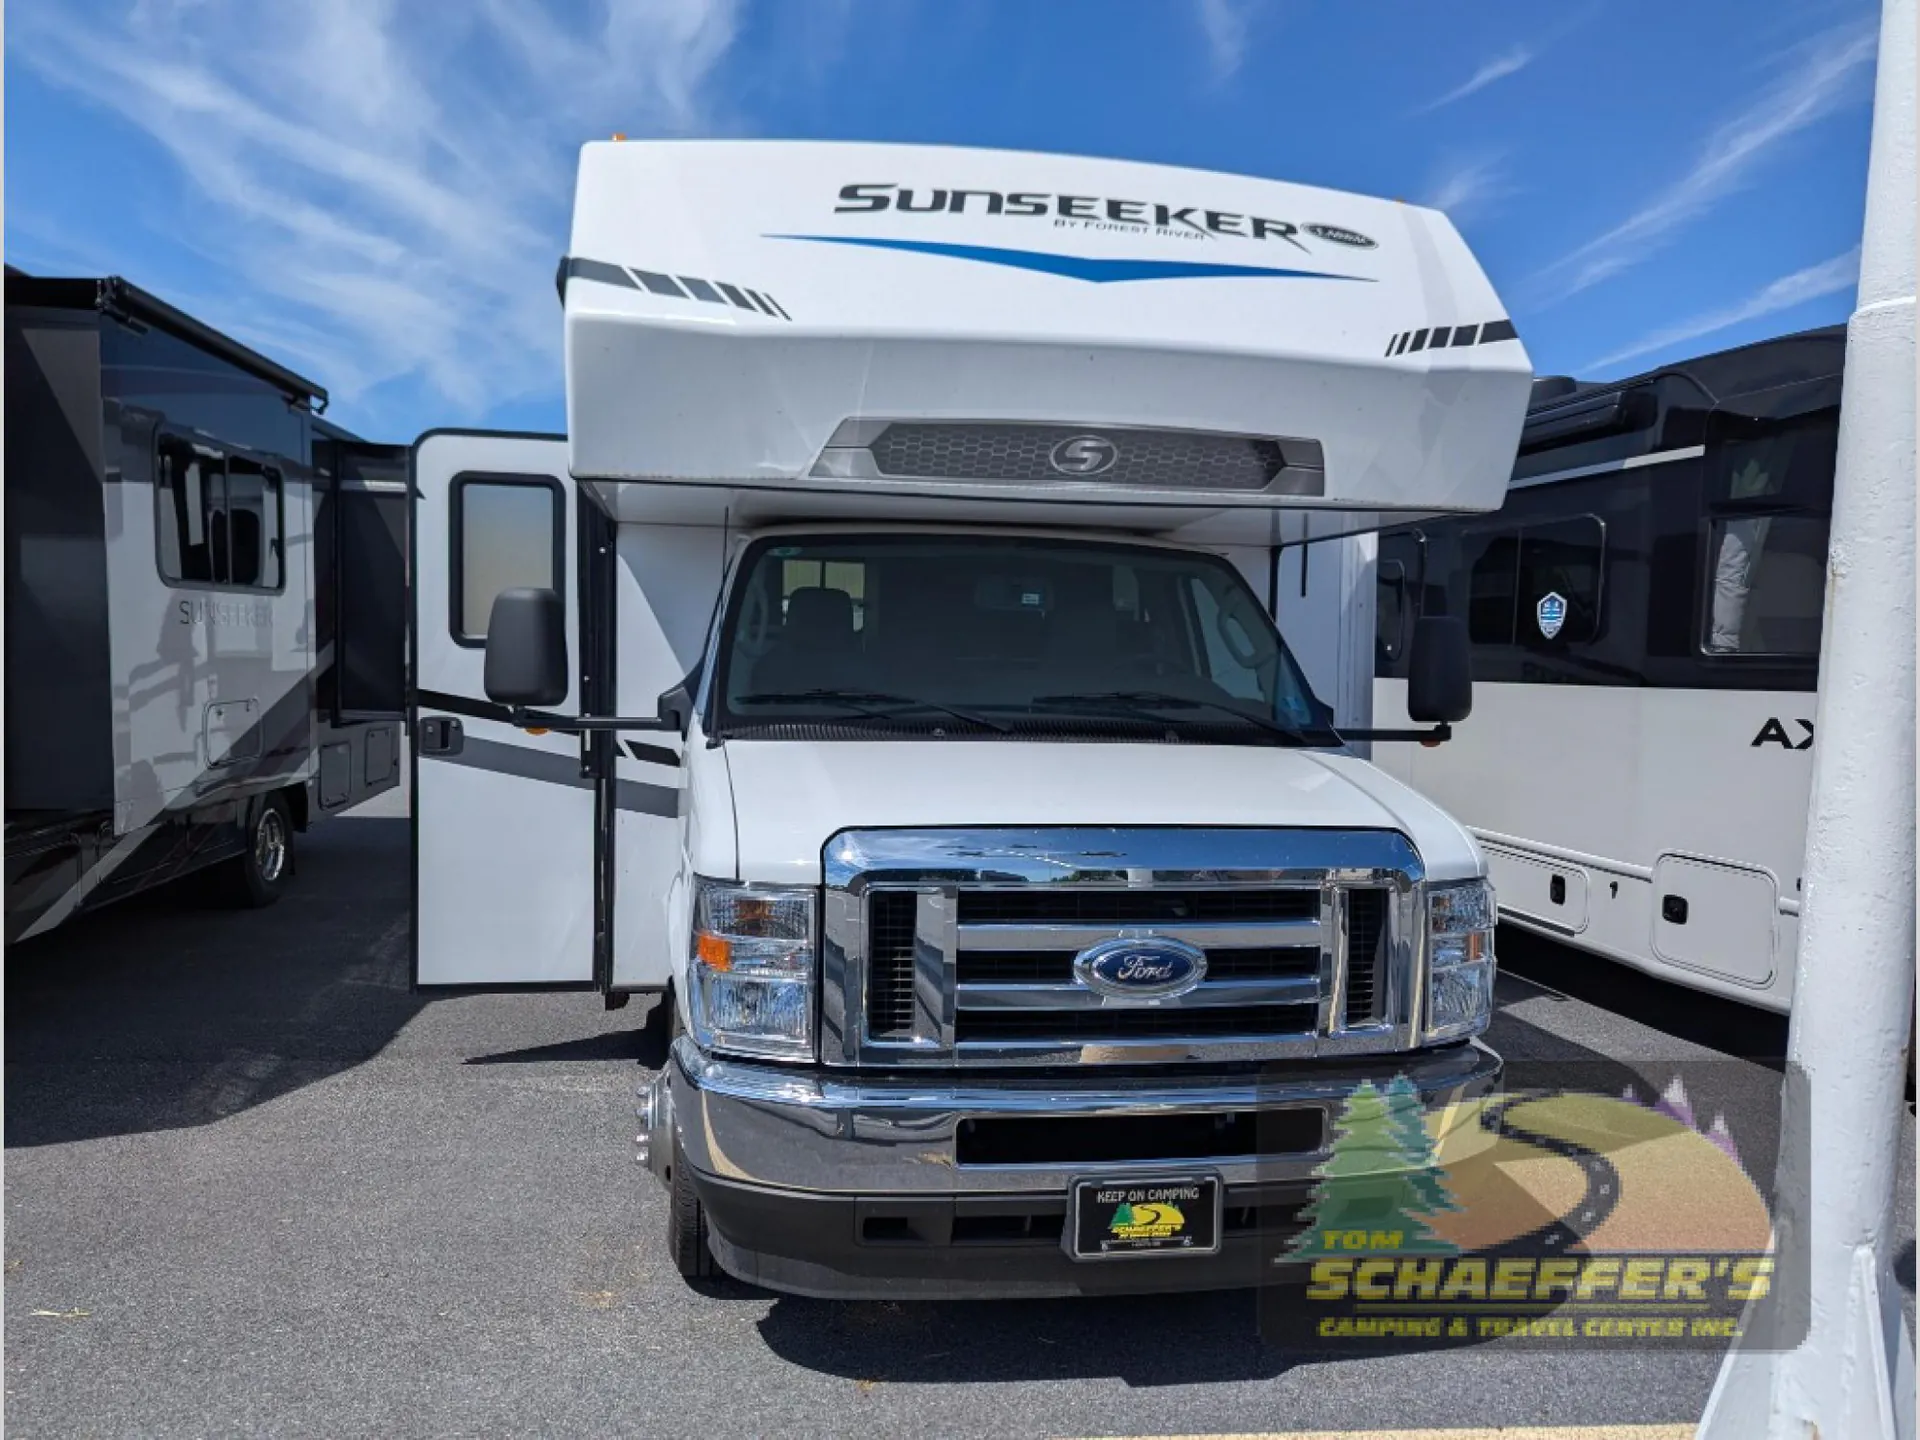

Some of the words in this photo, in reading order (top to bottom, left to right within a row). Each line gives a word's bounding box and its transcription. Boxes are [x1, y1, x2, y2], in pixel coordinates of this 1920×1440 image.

[833, 182, 1312, 254] SUNSEEKER
[1084, 220, 1149, 235] FOREST
[1155, 226, 1205, 241] RIVER
[1117, 953, 1175, 980] Ford
[1097, 1190, 1125, 1204] KEEP
[1127, 1189, 1146, 1202] ON
[1147, 1187, 1200, 1200] CAMPING
